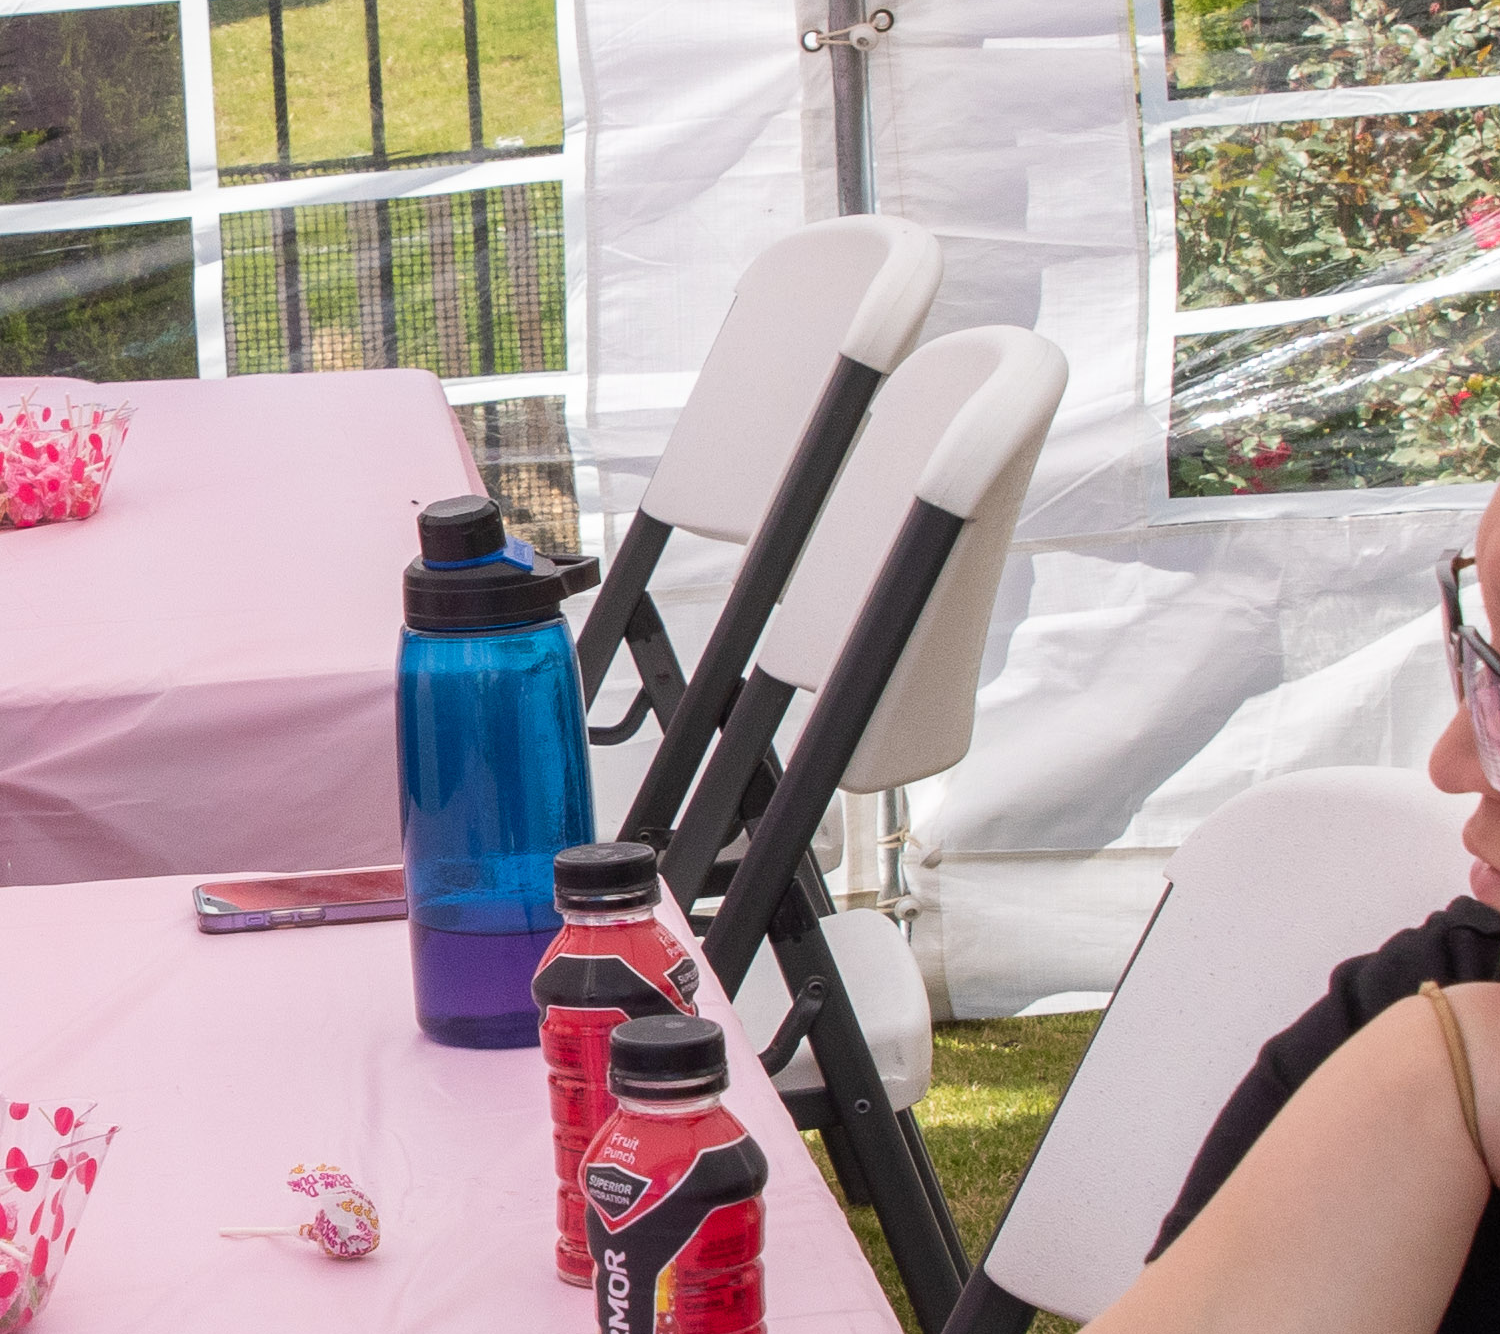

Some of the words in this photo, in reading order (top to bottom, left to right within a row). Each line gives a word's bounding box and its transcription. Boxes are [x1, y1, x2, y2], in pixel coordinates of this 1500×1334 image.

[610, 1132, 639, 1151] Fruit
[603, 1146, 636, 1165] Punch
[588, 1174, 633, 1195] SUPERIOR
